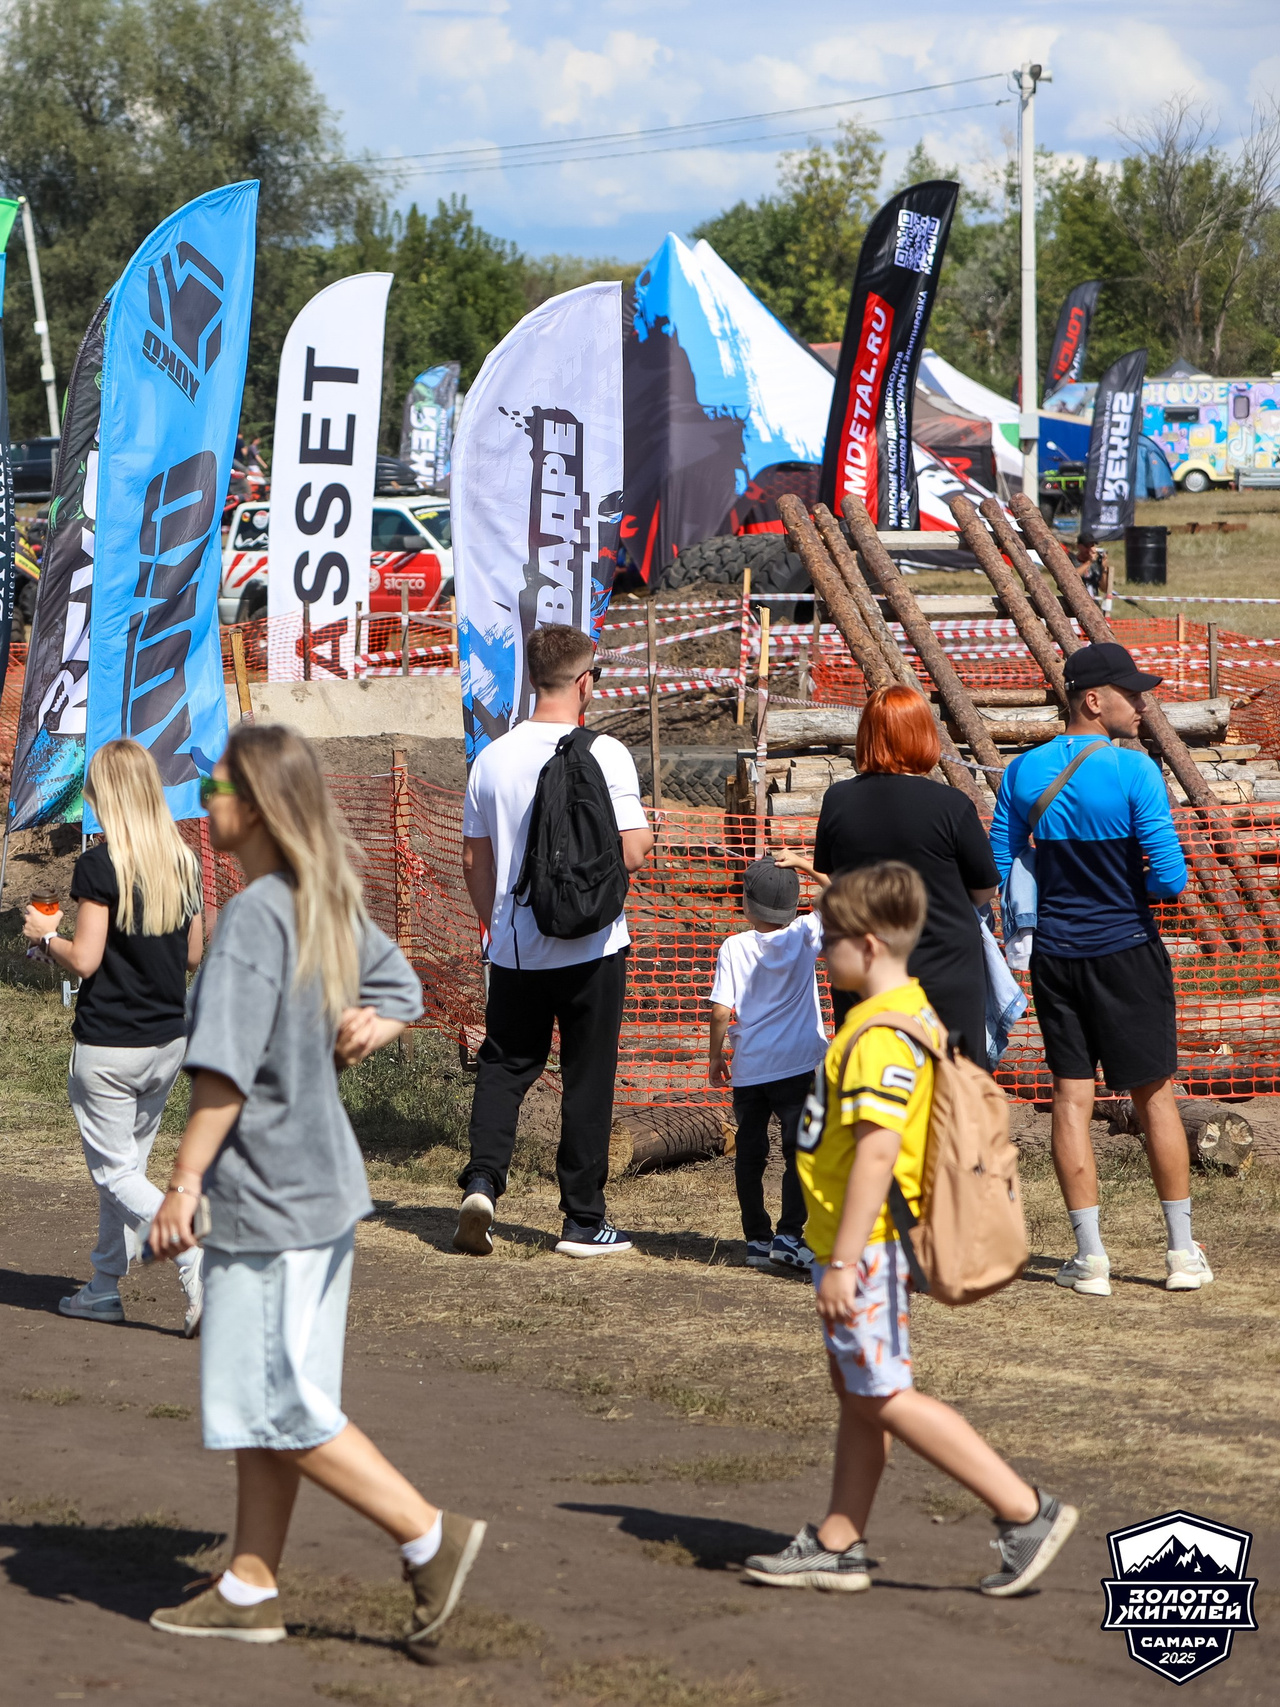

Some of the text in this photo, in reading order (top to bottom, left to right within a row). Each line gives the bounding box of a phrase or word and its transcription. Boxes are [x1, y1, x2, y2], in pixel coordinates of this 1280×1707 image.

[903, 290, 928, 363] ЭКИПИРОВКА
[899, 363, 908, 373] И
[1148, 383, 1228, 405] HOUSE
[843, 305, 888, 504] MDETAL.RU
[896, 374, 907, 437] АКСЕССУАРЫ
[888, 440, 898, 472] ЧАСТИ
[294, 346, 359, 679] ASSET
[535, 419, 581, 630] ВАДРЕ
[387, 589, 423, 597] PRSS
